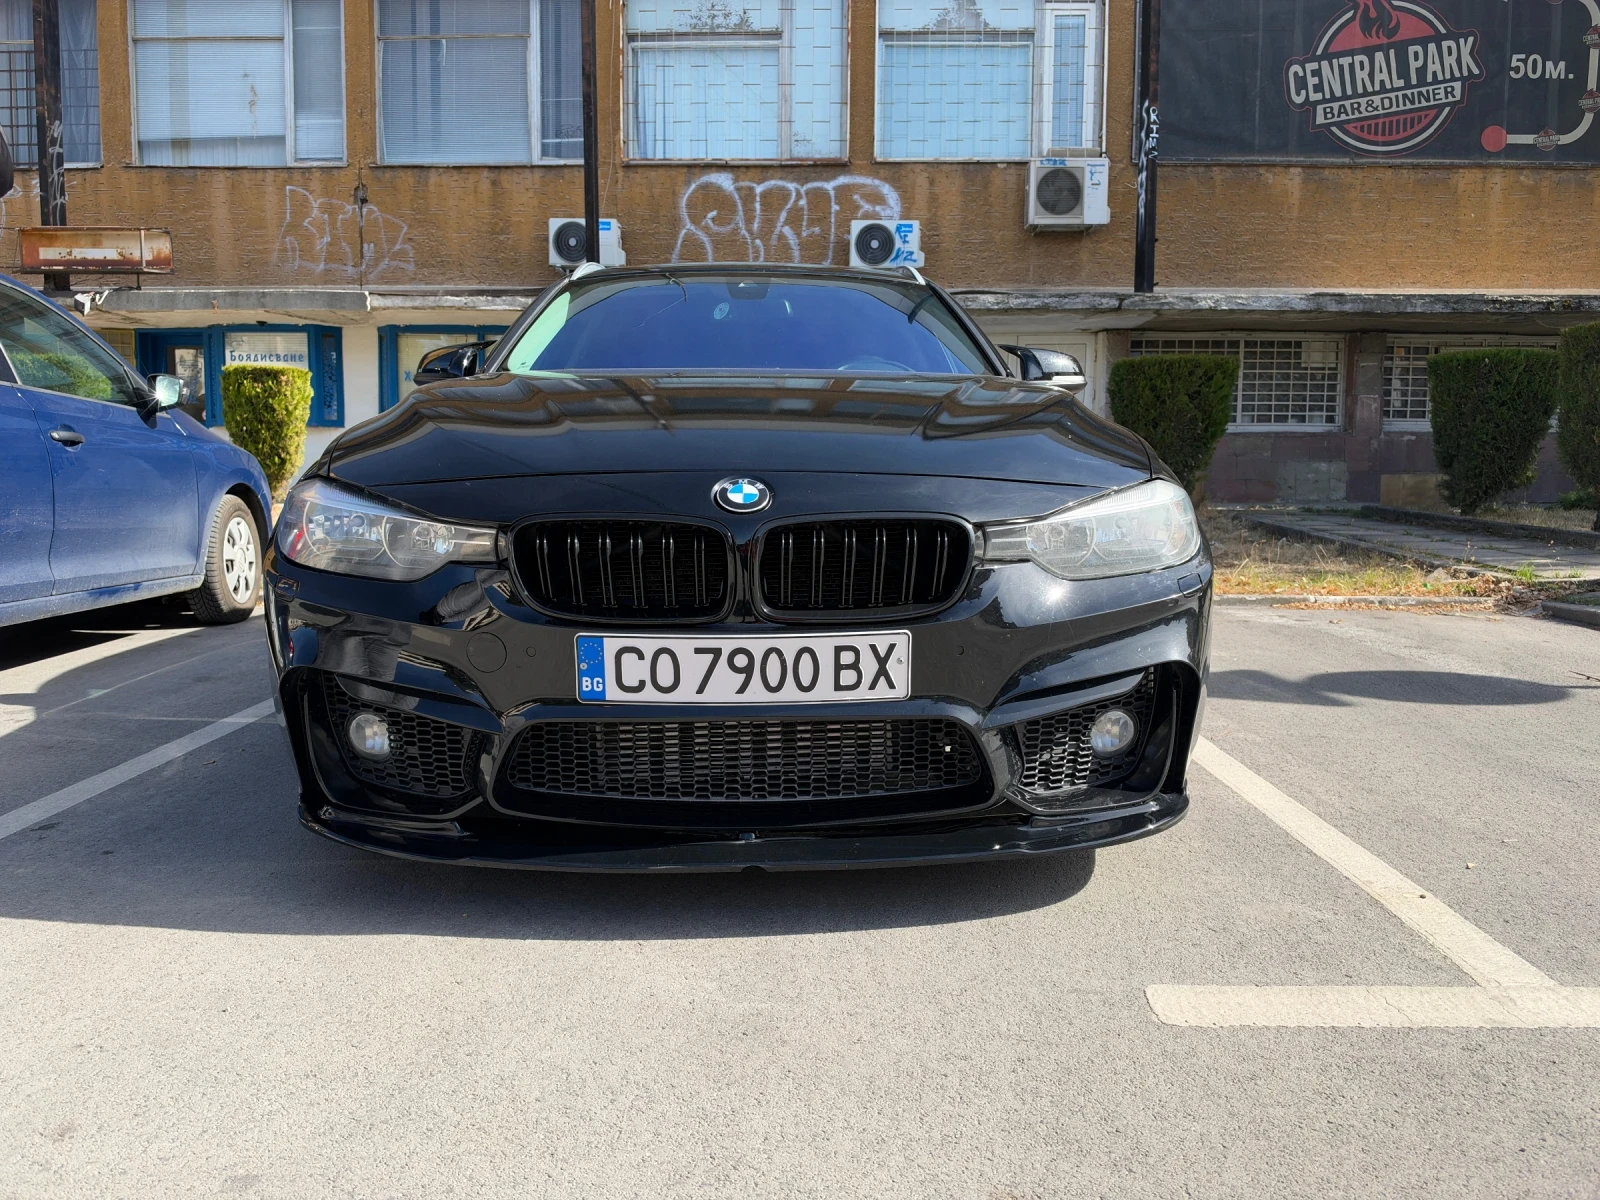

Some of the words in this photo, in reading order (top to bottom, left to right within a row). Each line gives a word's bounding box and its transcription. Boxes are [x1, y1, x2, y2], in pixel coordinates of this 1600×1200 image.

[1288, 48, 1405, 104] CENTRAL
[1408, 36, 1480, 85] PARK
[1323, 84, 1456, 121] BAR&DINNER
[229, 350, 305, 363] Боядисване
[723, 479, 766, 490] BMW
[614, 645, 681, 694] CO
[693, 645, 820, 695] 7900
[833, 642, 898, 692] BX
[582, 676, 604, 692] BG
